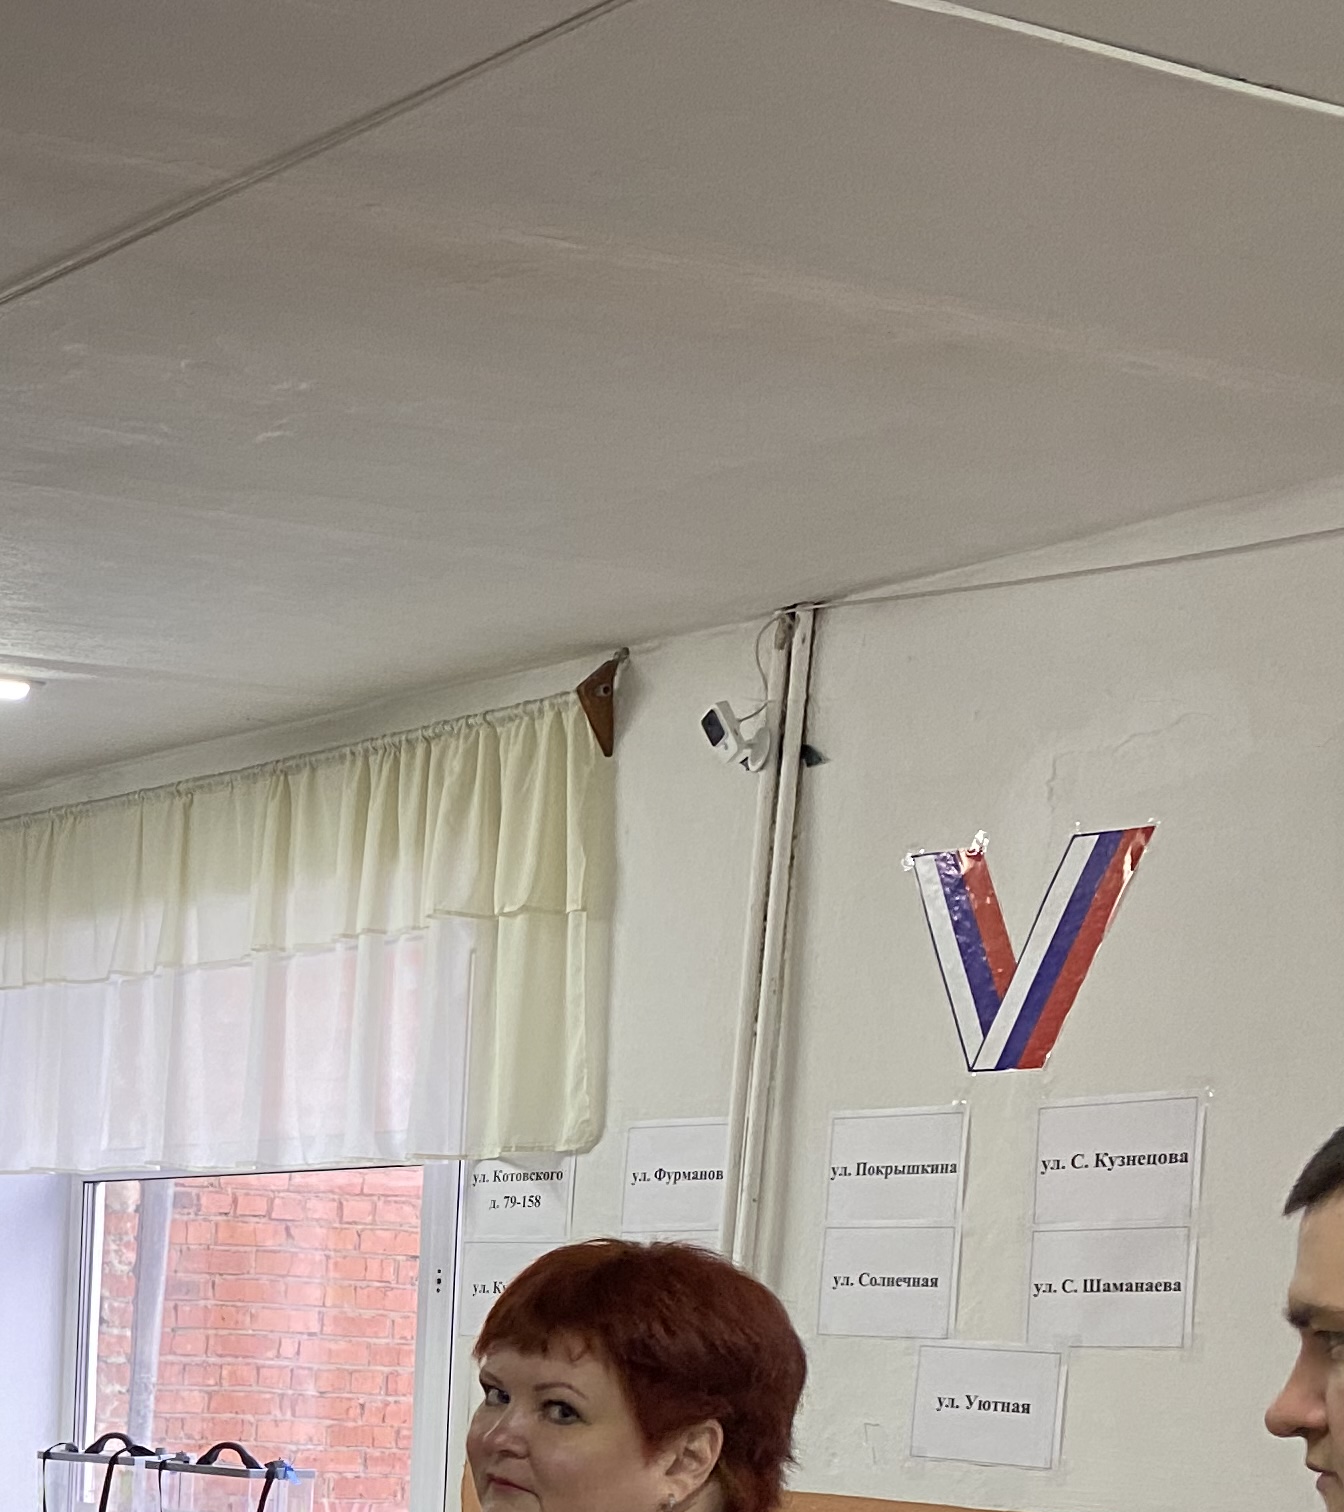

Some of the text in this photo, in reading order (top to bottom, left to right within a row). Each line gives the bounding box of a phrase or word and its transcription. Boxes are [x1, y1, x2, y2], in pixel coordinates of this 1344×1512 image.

[830, 1161, 958, 1181] ул. Покрышкина
[1040, 1150, 1190, 1176] ул. С. Кузнецова
[472, 1169, 564, 1188] ул. Котовского
[630, 1171, 651, 1186] ул.
[489, 1194, 542, 1211] д. 79-158
[472, 1283, 490, 1297] ул.
[832, 1272, 939, 1290] ул. Солнечная
[1032, 1278, 1182, 1298] ул. С. Шаманаева
[935, 1394, 1032, 1415] ул. Уютная
